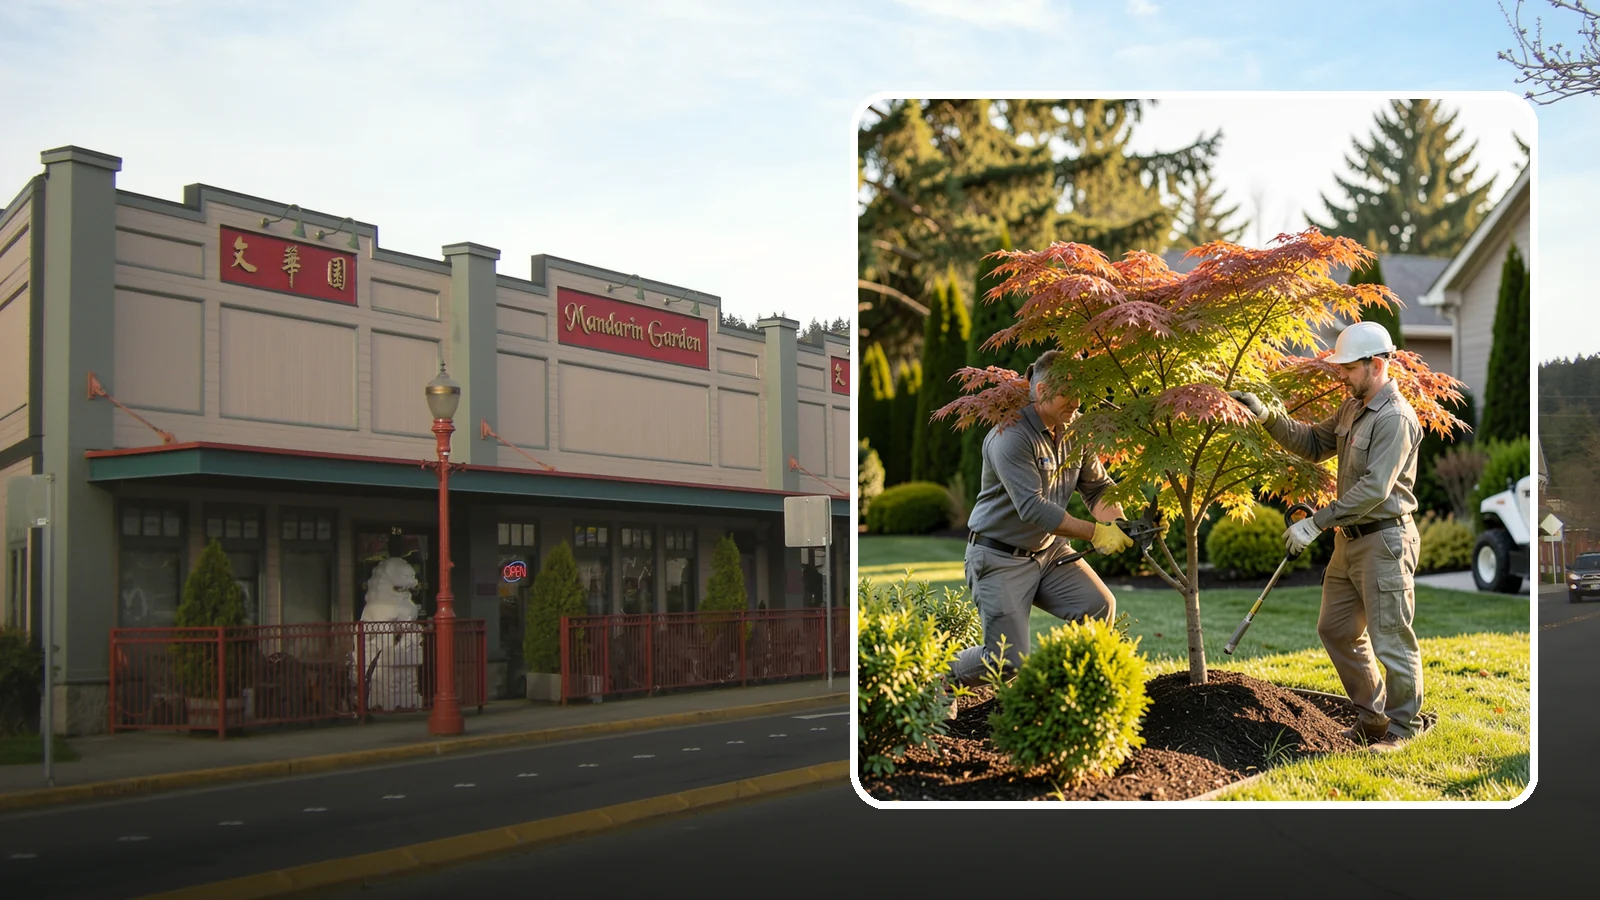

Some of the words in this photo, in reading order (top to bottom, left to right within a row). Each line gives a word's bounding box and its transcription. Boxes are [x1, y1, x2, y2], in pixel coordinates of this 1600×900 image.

[565, 302, 644, 341] Mandarin
[648, 320, 701, 352] Garden
[503, 565, 527, 578] OPEN
